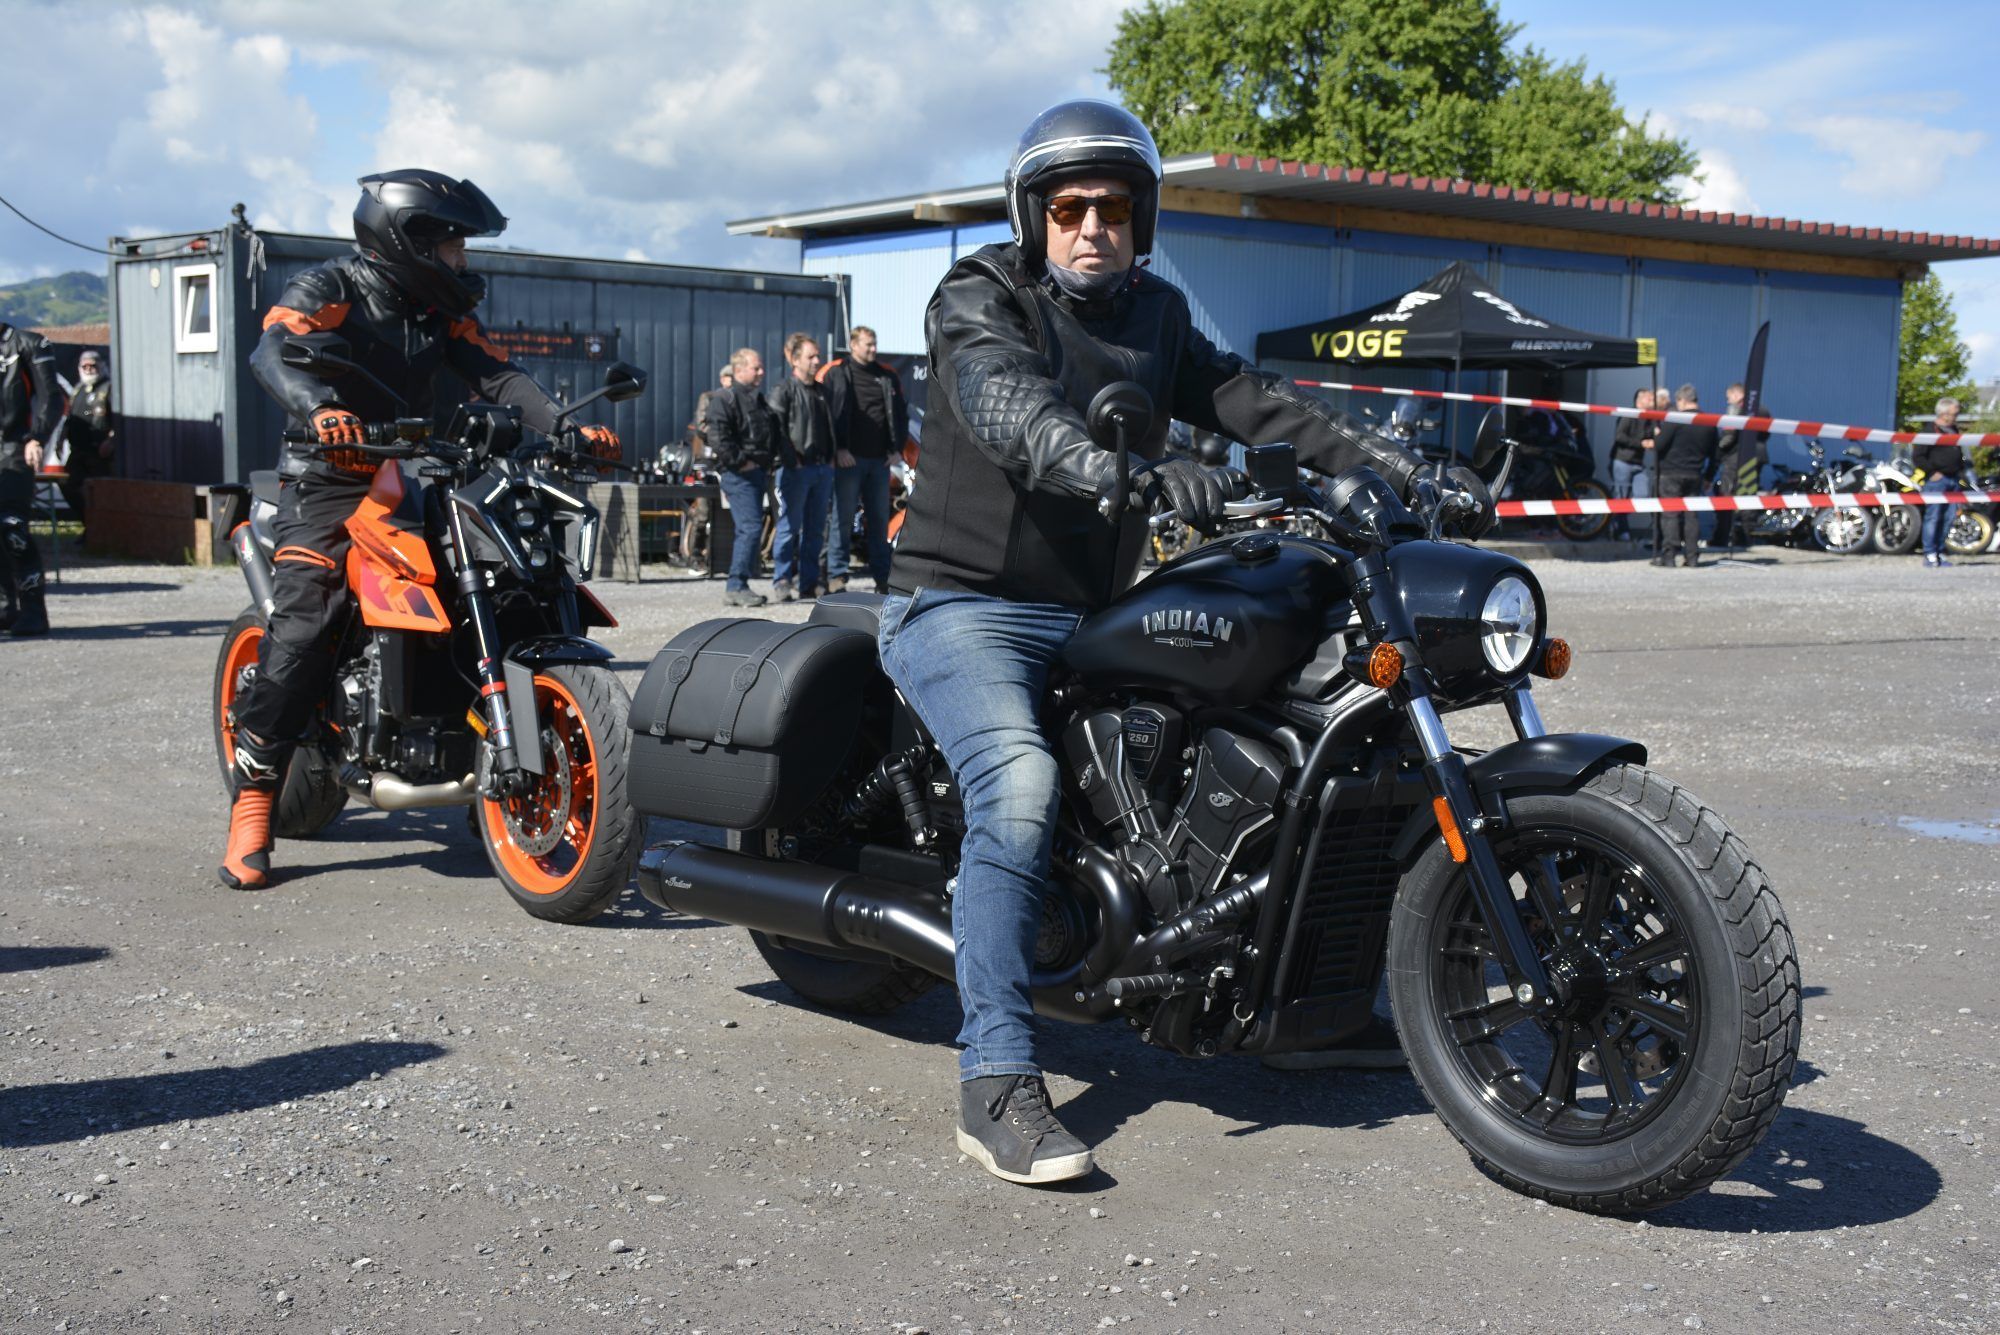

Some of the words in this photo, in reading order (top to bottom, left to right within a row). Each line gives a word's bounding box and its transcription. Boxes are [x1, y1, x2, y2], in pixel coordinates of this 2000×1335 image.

[1311, 329, 1408, 358] VOGE
[1142, 609, 1234, 642] INDIAN
[1170, 637, 1195, 648] SCOUT
[1128, 732, 1149, 744] 1250
[1639, 1081, 1712, 1162] PIRELLI
